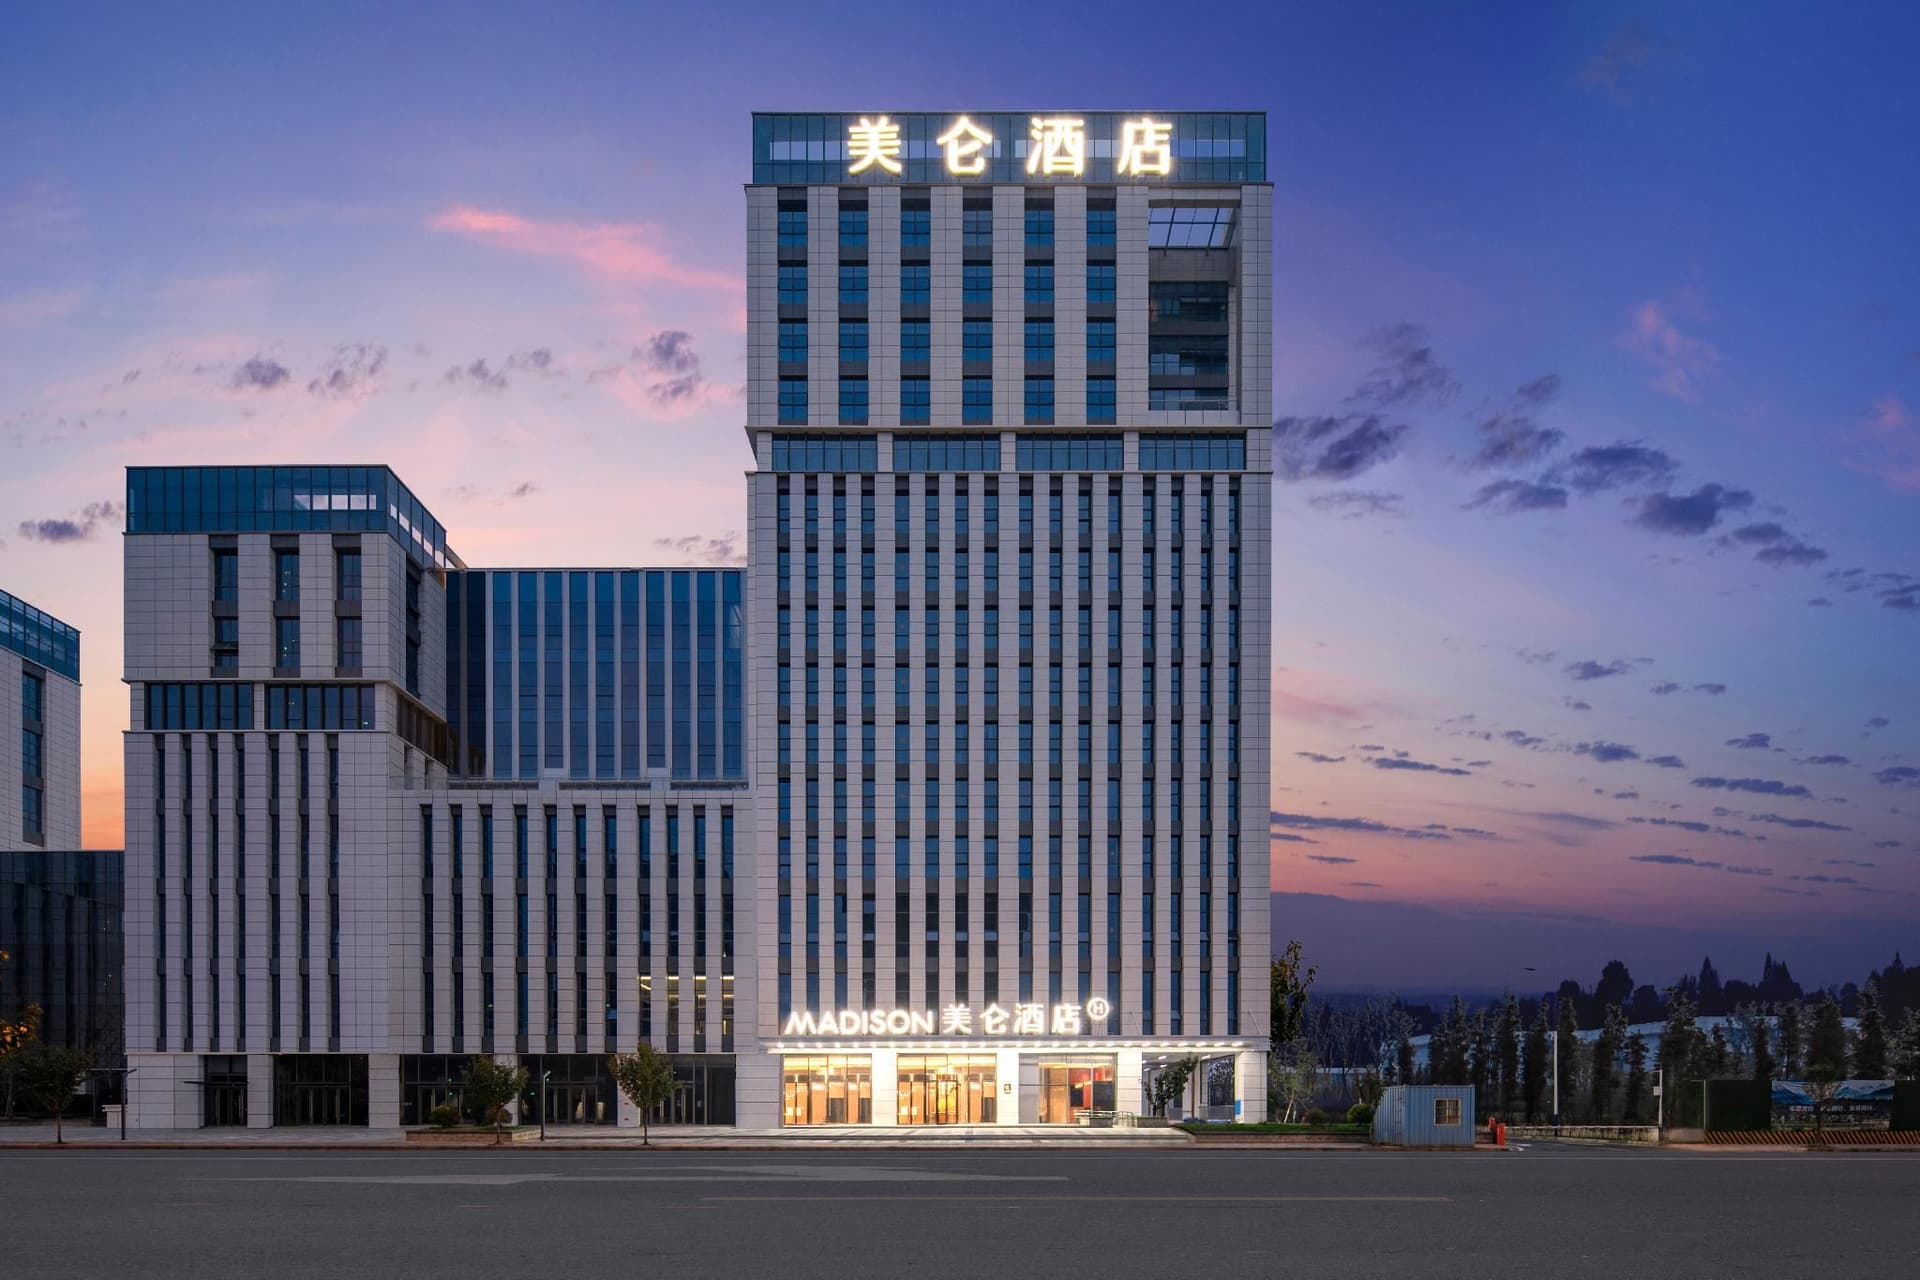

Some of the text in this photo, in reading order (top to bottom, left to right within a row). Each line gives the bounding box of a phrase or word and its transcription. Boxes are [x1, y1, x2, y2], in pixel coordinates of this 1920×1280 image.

[847, 115, 1173, 175] 美仑酒店
[785, 1008, 933, 1035] MADISON
[943, 1002, 1082, 1034] 美仑酒店
